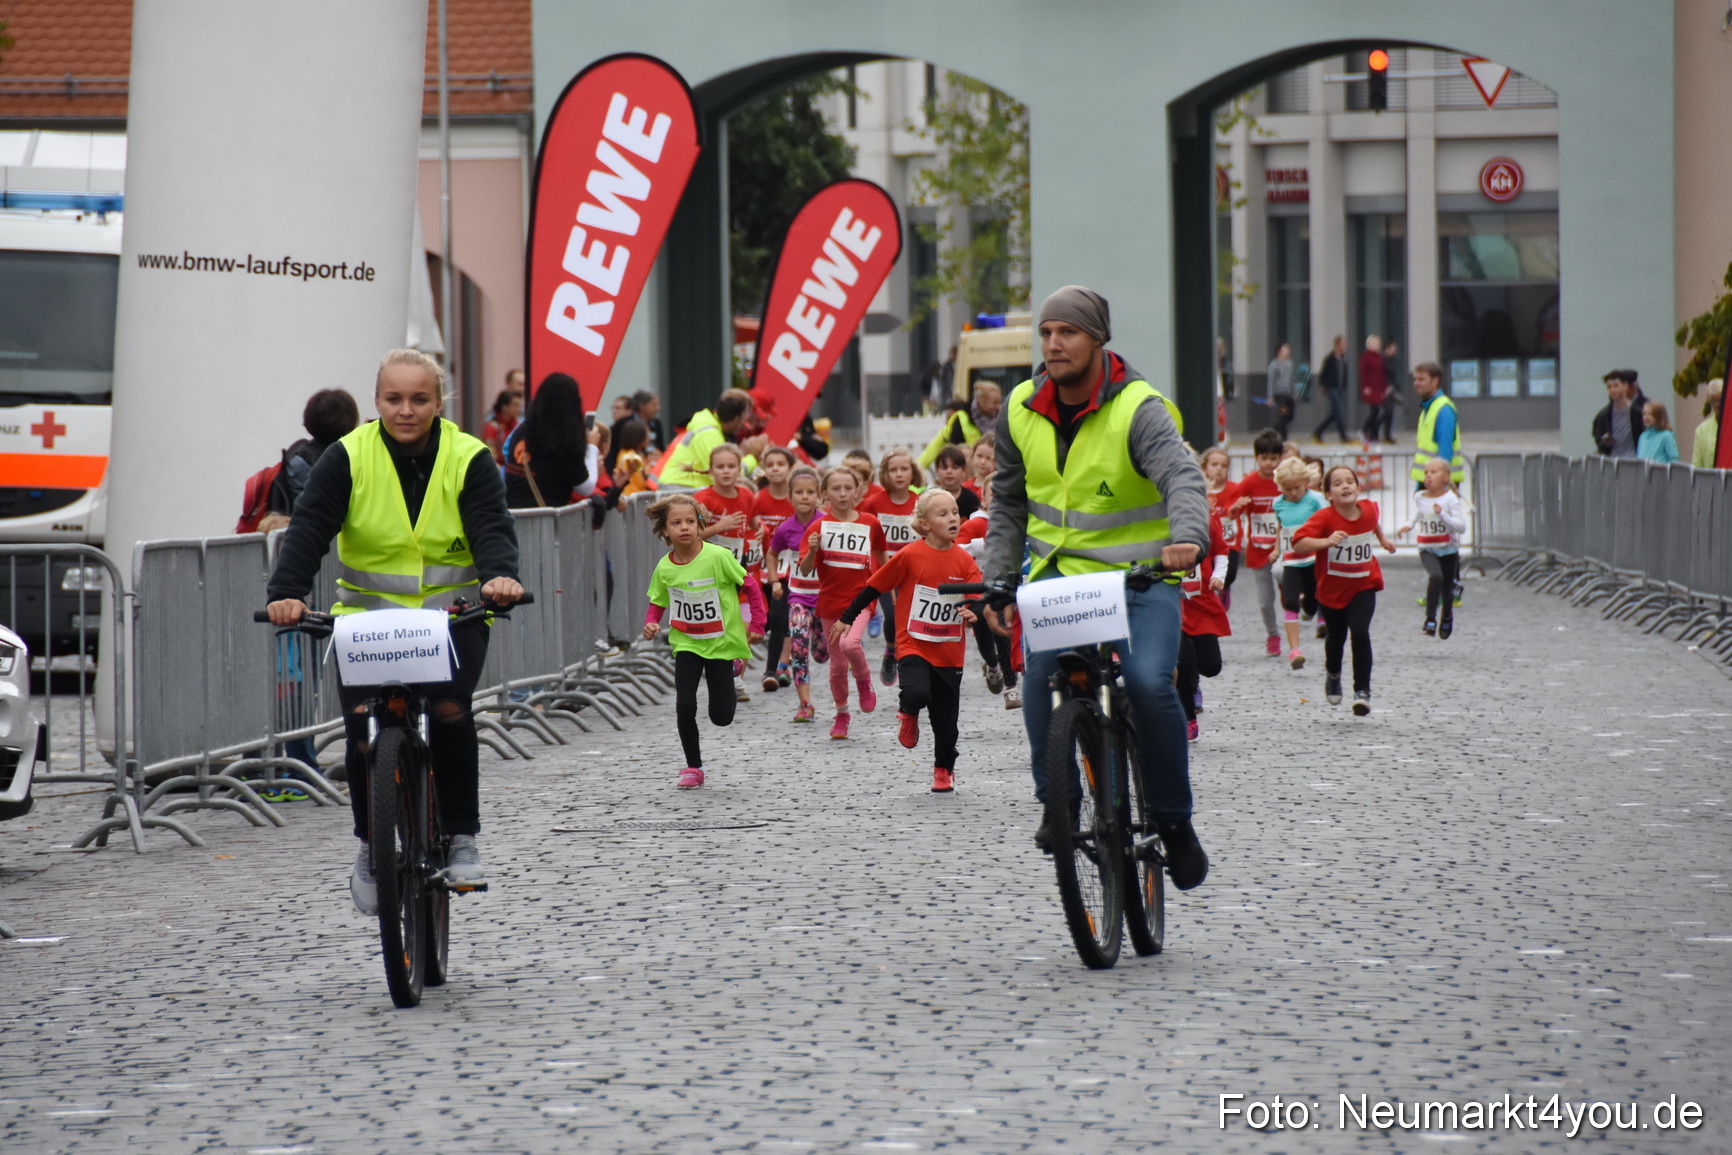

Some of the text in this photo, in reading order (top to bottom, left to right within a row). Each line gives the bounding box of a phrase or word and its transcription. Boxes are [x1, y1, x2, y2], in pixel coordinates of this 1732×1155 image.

[545, 91, 672, 357] REWE
[138, 251, 376, 281] www.bmw-laufsport.de
[767, 206, 882, 390] REWE
[882, 524, 909, 541] 706
[1254, 522, 1277, 535] 715
[826, 531, 867, 552] 7167
[1333, 543, 1371, 562] 7190
[1040, 589, 1102, 607] Erste Frau
[673, 599, 717, 621] 7055
[1031, 604, 1118, 629] Schnupperlauf
[352, 627, 432, 643] Erster Mann
[347, 644, 440, 663] Schnupperlauf
